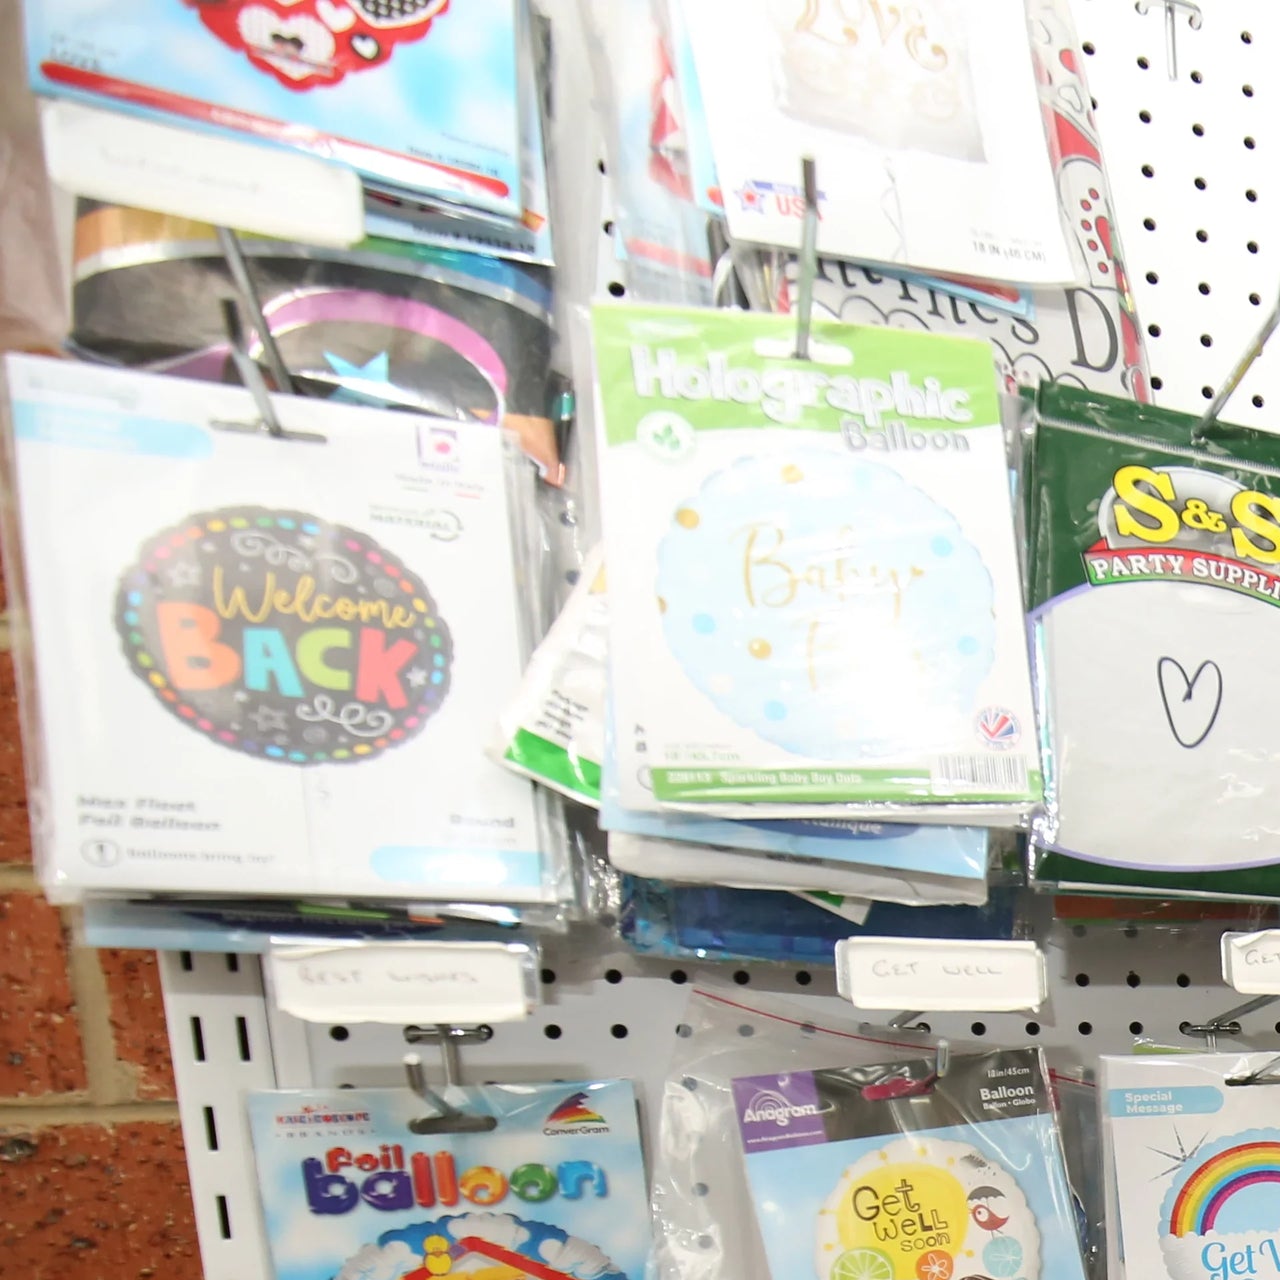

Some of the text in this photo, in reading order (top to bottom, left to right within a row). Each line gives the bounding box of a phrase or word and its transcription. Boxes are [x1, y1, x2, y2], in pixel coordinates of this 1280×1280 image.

[630, 345, 974, 428] Holographic
[840, 421, 971, 453] Balloon
[1090, 554, 1185, 582] PARTY
[212, 565, 416, 628] Welcome
[155, 600, 417, 709] BACK
[871, 960, 919, 978] GET
[980, 1083, 1034, 1102] Balloon
[1125, 1091, 1173, 1104] Special
[743, 1102, 818, 1127] Anagram
[1125, 1101, 1183, 1114] Message
[543, 1123, 610, 1137] ConverGram
[302, 1149, 609, 1215] balloon
[852, 1178, 921, 1222] Get
